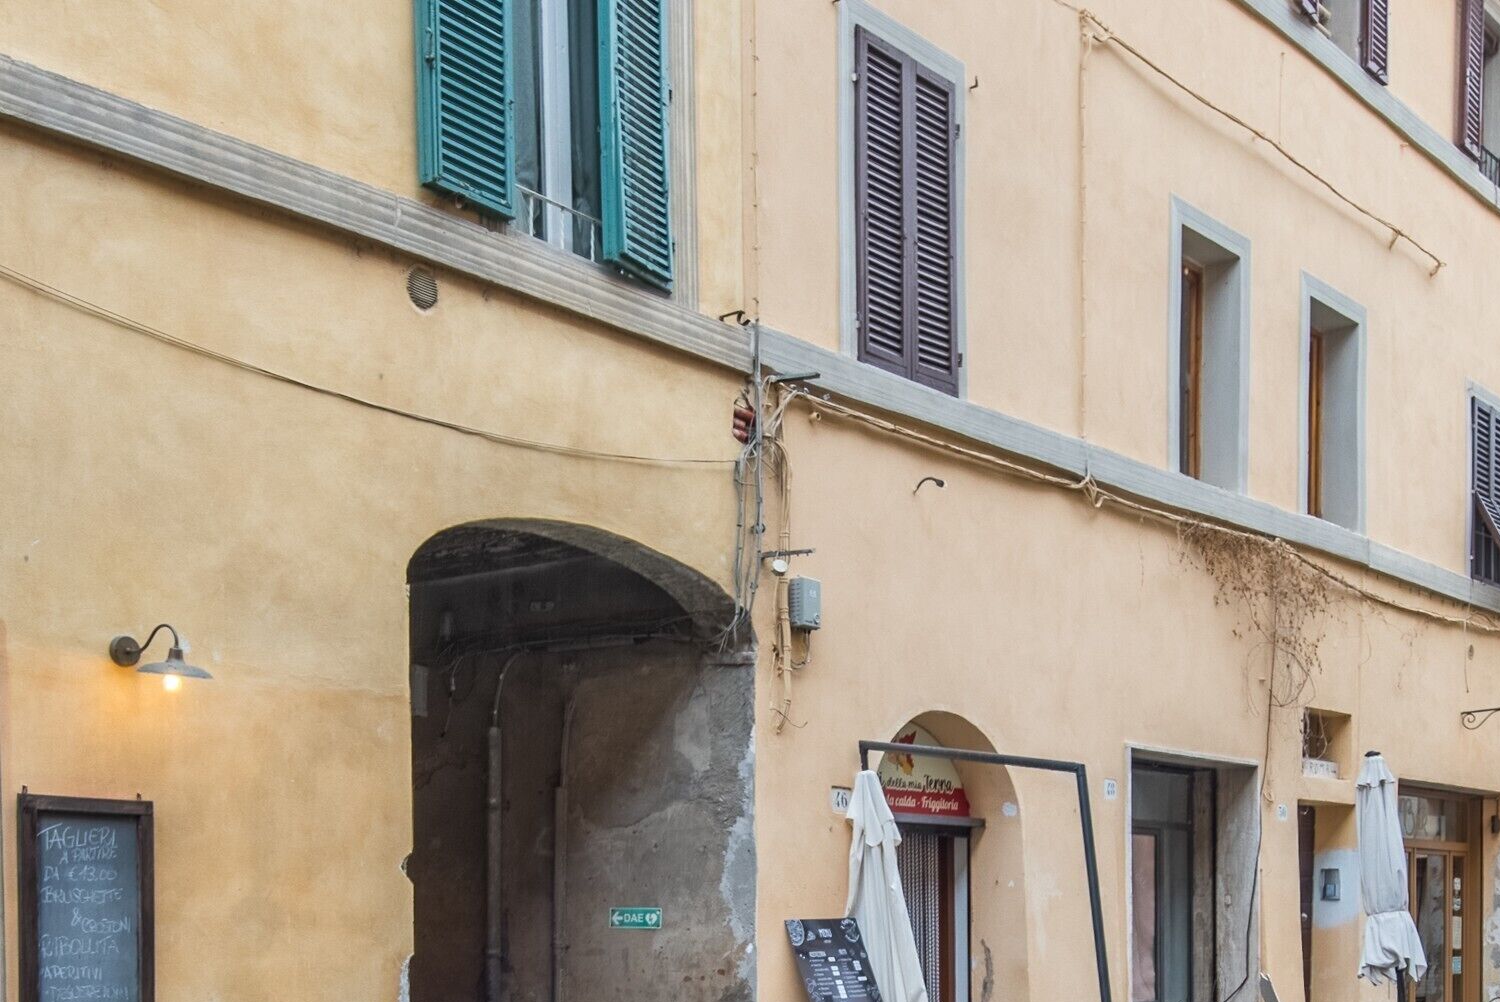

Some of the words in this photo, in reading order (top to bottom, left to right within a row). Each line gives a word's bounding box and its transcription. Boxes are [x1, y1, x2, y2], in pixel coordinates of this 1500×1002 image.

[886, 776, 906, 789] della
[923, 774, 954, 793] Terra
[895, 795, 917, 807] calda
[921, 796, 960, 813] Friggitoria
[37, 822, 118, 851] TAGLIERI
[43, 866, 60, 882] DA
[623, 913, 644, 923] DAE
[44, 965, 102, 980] APERITIVI
